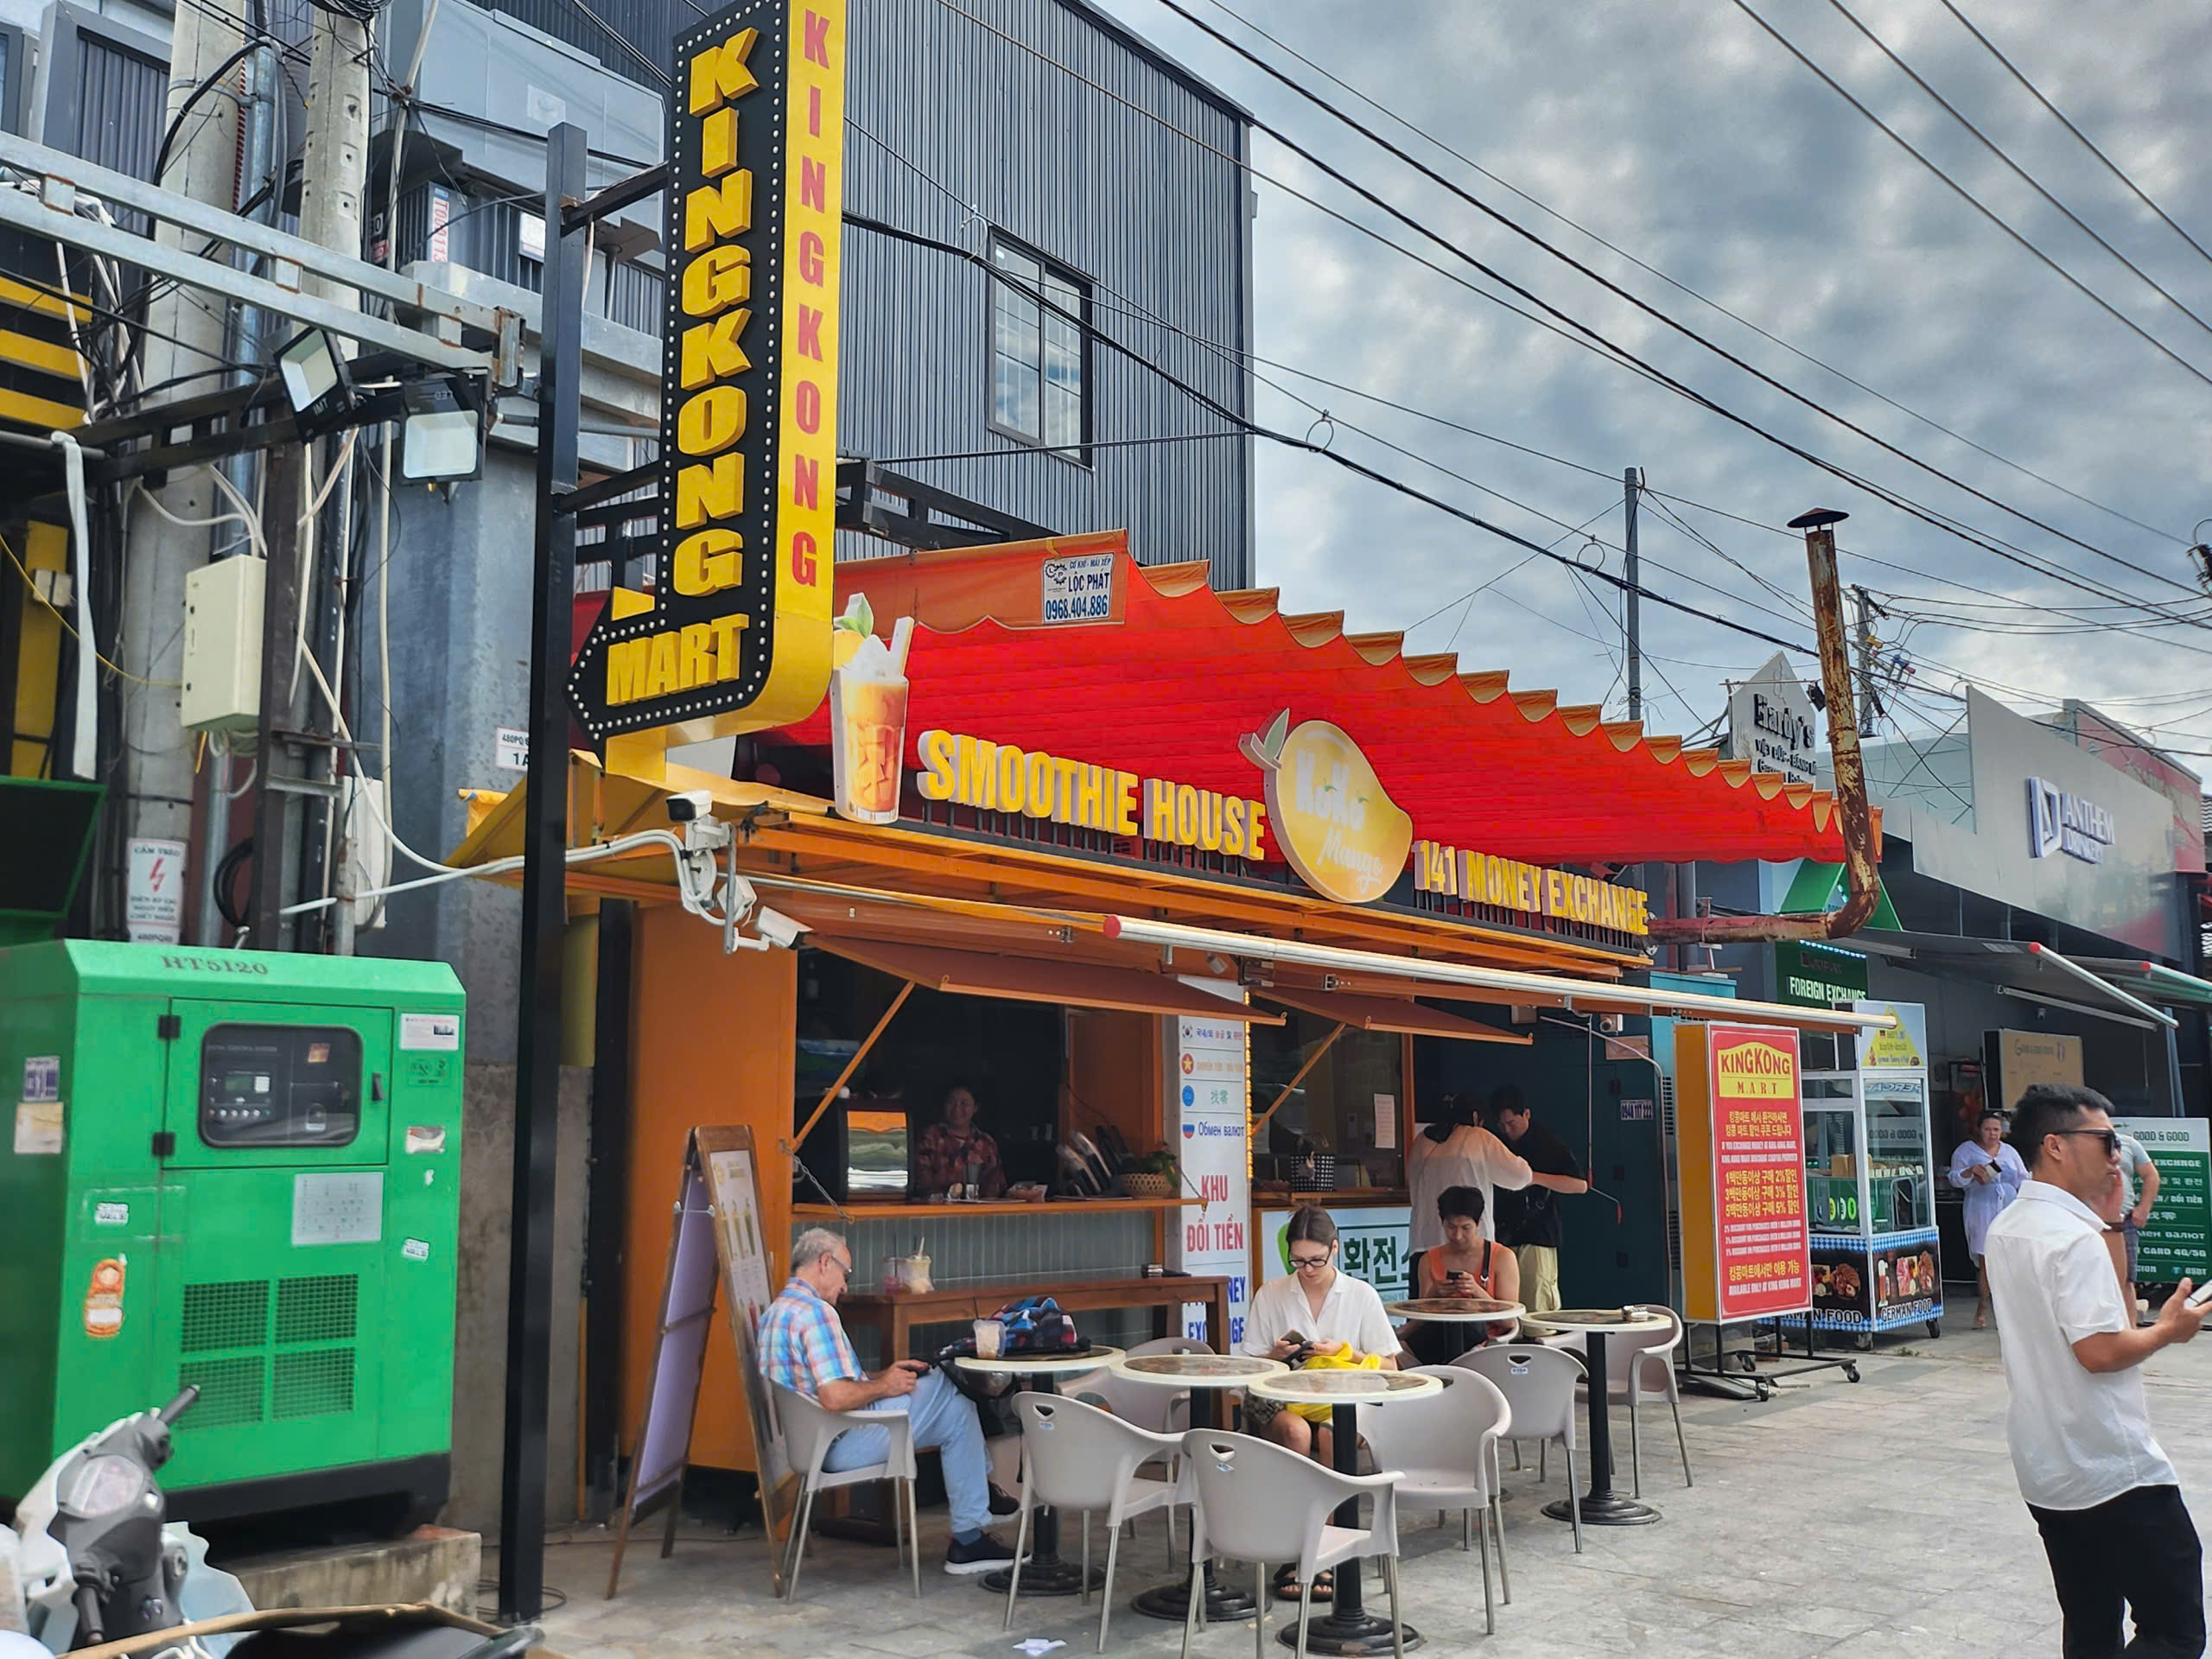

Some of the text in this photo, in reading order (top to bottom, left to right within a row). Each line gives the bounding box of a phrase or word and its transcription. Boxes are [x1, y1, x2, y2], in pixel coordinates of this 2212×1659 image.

[791, 9, 830, 587] KINGKONG
[673, 28, 760, 597] KINGKONG
[1068, 569, 1109, 594] LỘC PHÁT
[1046, 594, 1109, 620] 0968.404.886
[607, 613, 749, 707] MART
[917, 729, 1265, 861] SMOOTHIE HOUSE
[2062, 793, 2115, 845] ANTHEM
[1411, 840, 1649, 935] 141 MONEY EXCHANGE
[1789, 976, 1866, 1001] FOREIGN EXCHANGE
[1721, 1048, 1790, 1075] KINGKONG
[1198, 1122, 1244, 1137] Обмен валют
[2133, 1131, 2190, 1142] GOOD & GOOD
[1201, 1175, 1228, 1202] KHU
[1186, 1211, 1243, 1252] ĐỔI TIỀN
[2143, 1247, 2171, 1255] CARD
[1788, 1260, 1800, 1274] 가능
[1827, 1309, 1862, 1323] FOOD
[1881, 1298, 1933, 1322] GERMAN FOOD
